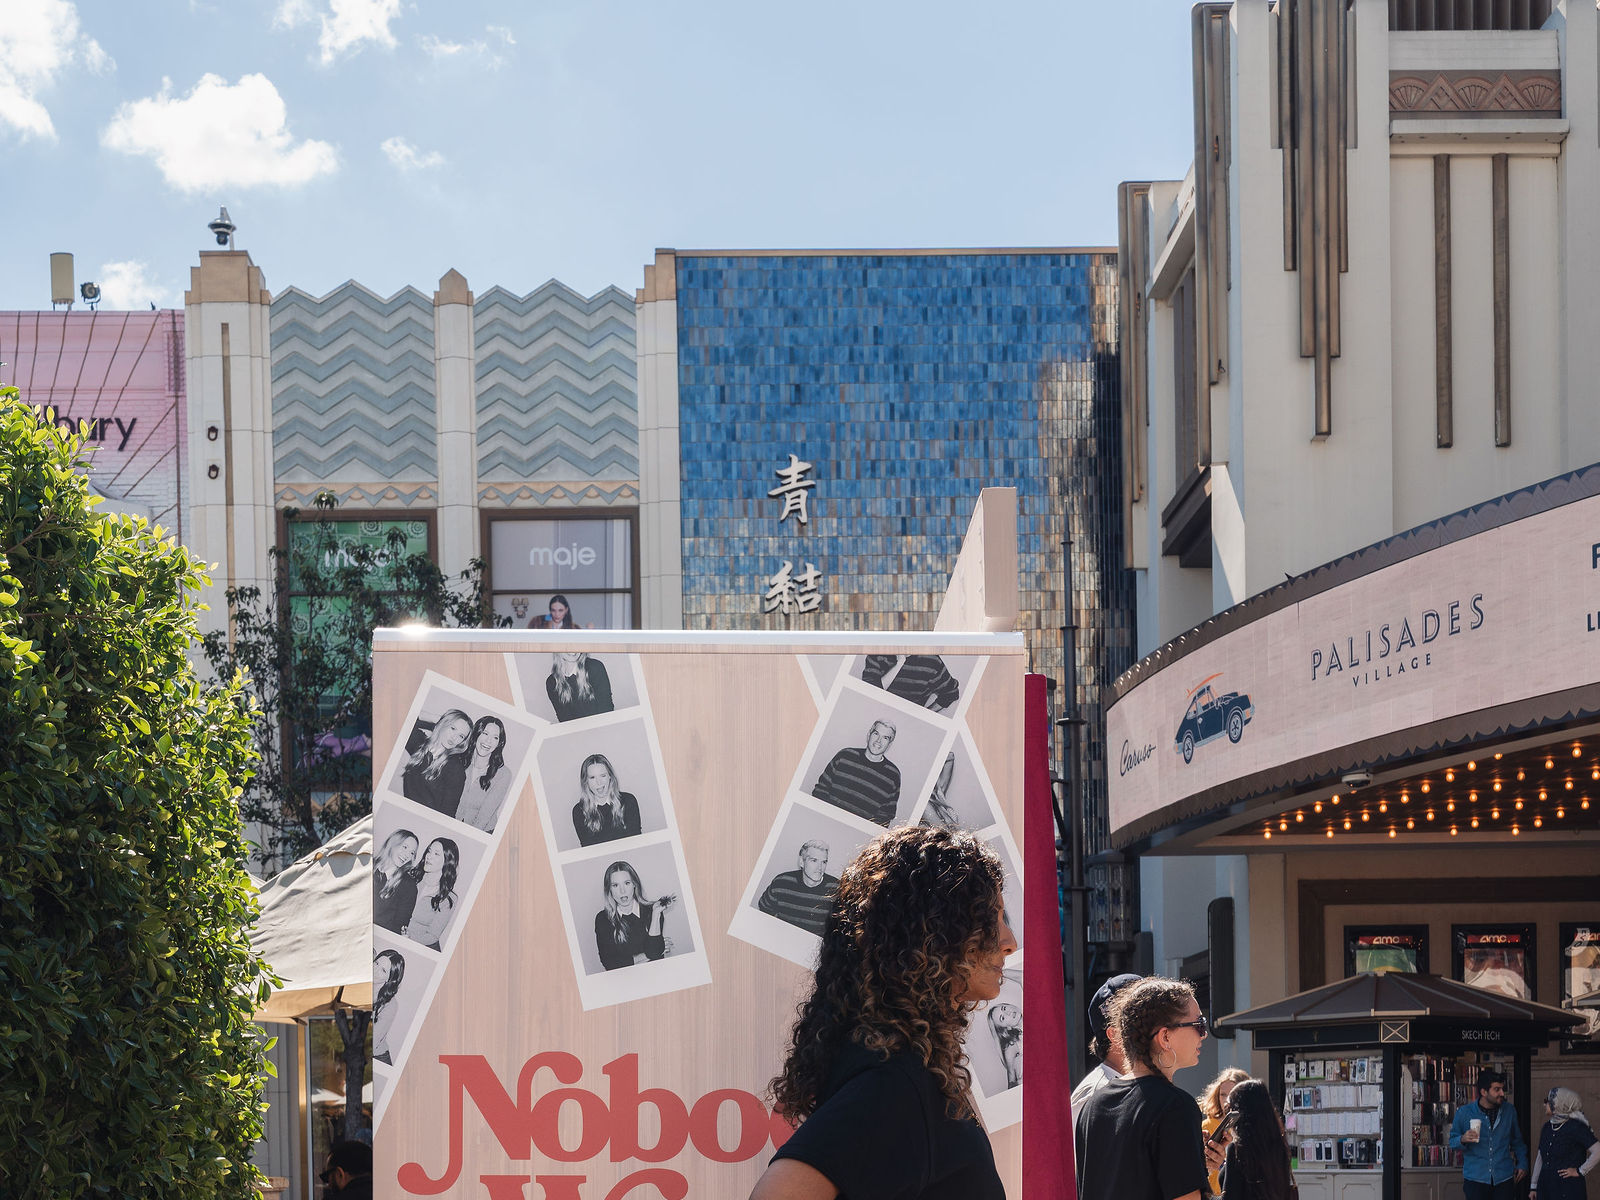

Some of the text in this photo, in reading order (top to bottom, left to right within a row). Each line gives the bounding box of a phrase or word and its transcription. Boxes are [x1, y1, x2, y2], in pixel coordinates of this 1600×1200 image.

[25, 404, 137, 452] bury
[529, 542, 597, 570] maje
[1311, 593, 1485, 681] PALISADES
[1352, 653, 1432, 688] VILLAGE
[1120, 739, 1156, 777] Caruso
[1461, 1029, 1501, 1041] SKECH TECH
